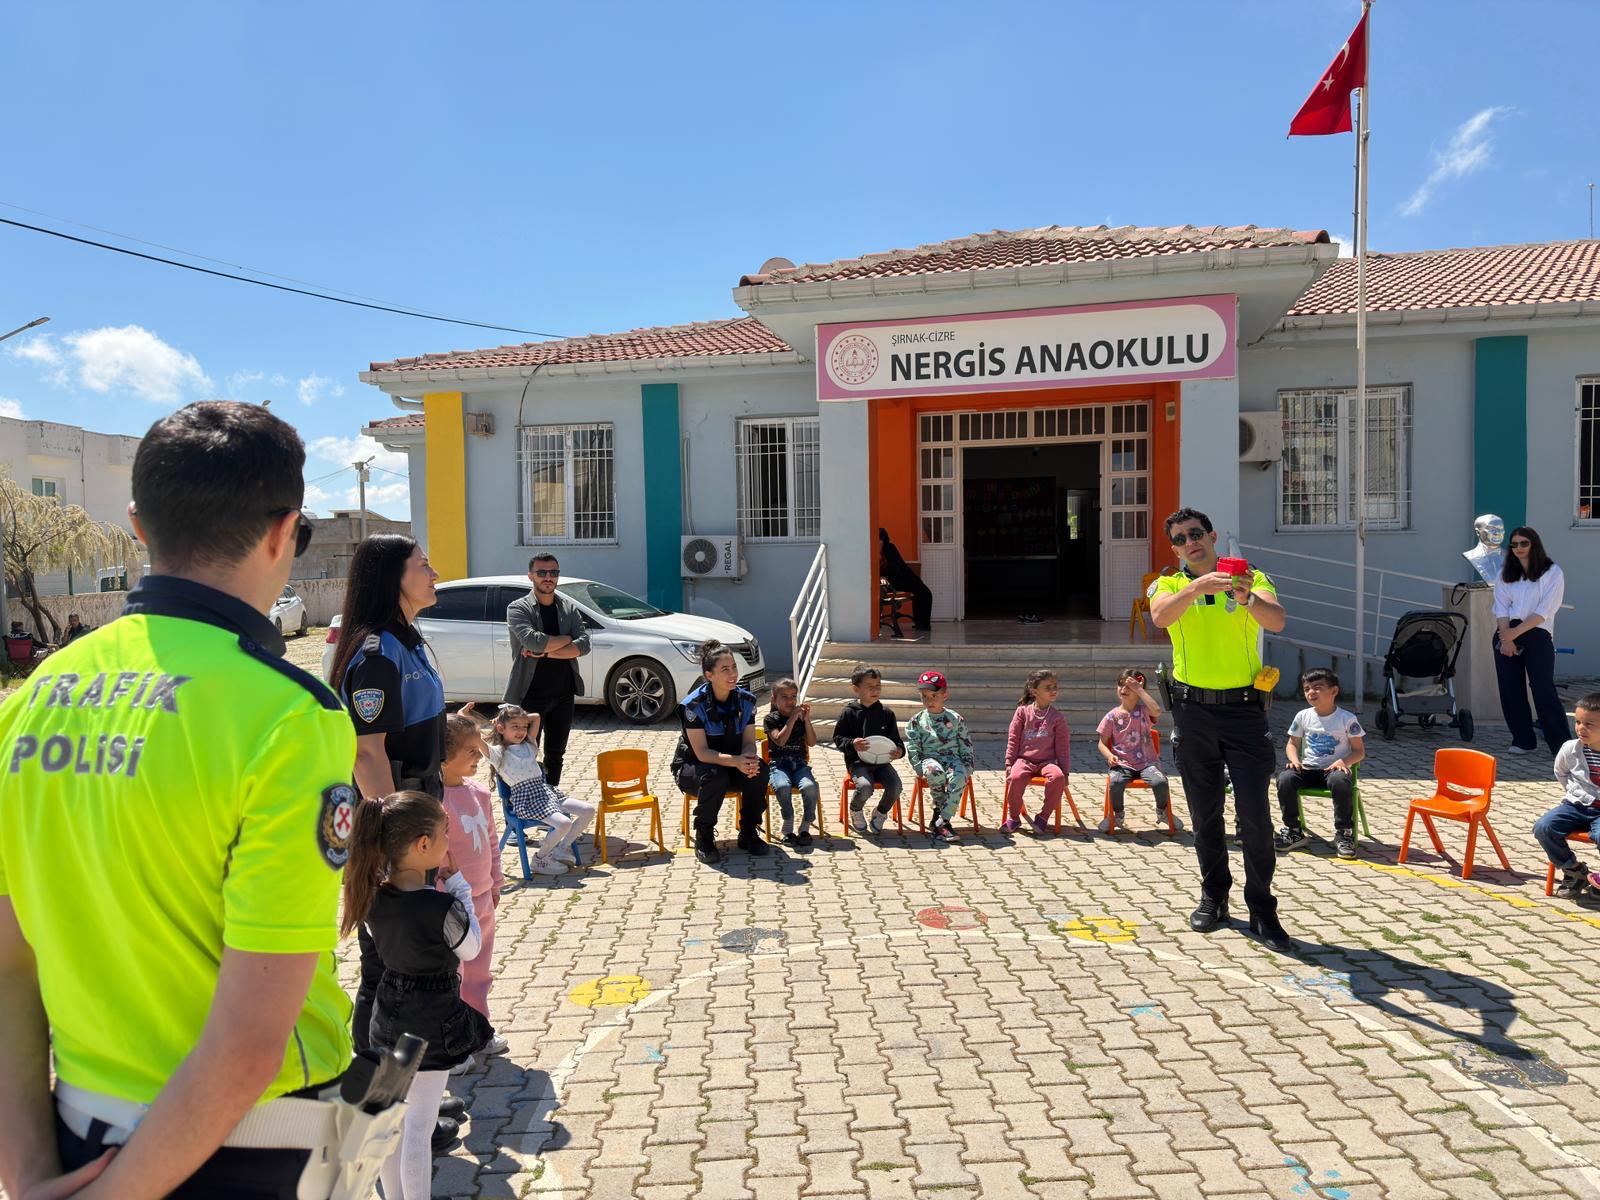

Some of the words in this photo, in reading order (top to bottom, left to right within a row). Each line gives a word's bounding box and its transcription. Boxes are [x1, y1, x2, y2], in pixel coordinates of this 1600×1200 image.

[891, 331, 955, 346] ŞIRNAK-CİZRE
[891, 342, 1006, 382] NERGİS
[1015, 333, 1209, 374] ANAOKULU
[724, 541, 732, 571] REGAL
[28, 672, 191, 713] TRAFİK
[9, 734, 145, 777] POLİSİ
